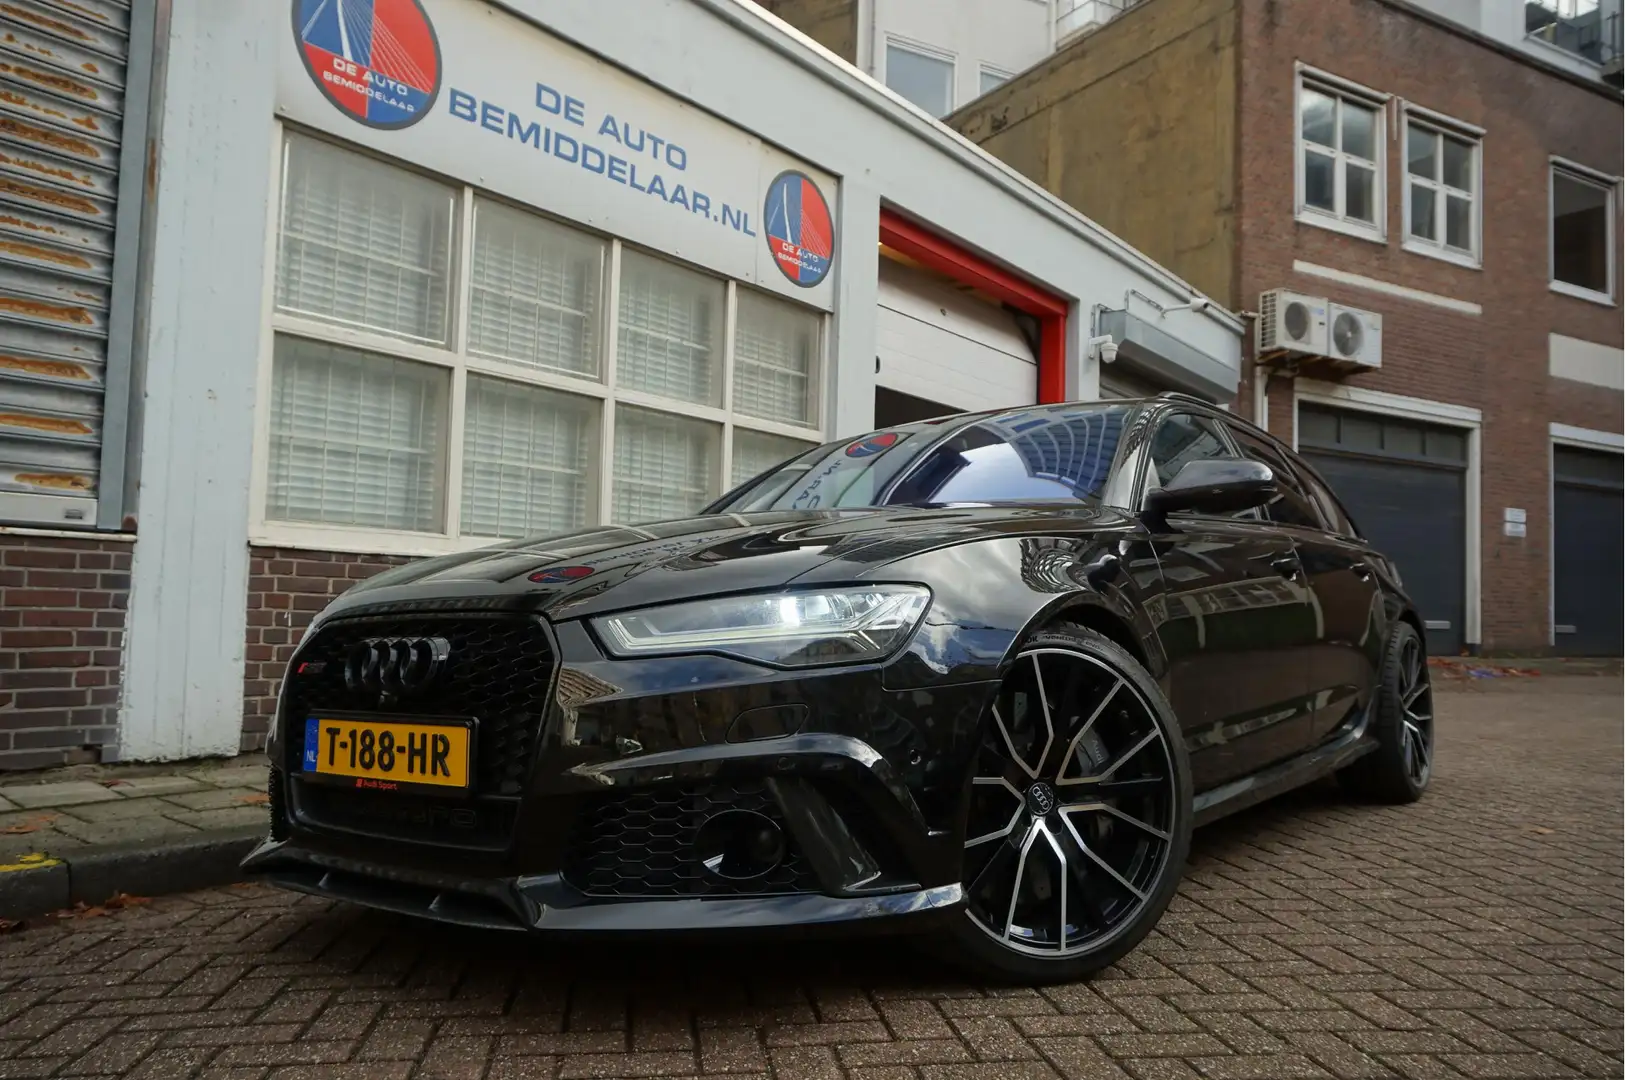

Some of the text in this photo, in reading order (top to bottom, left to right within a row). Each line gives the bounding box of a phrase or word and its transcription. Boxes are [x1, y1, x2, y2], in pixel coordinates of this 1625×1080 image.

[322, 70, 415, 113] BEMIDDELAAR
[333, 57, 408, 96] DE AUTO
[535, 82, 687, 171] DE AUTO
[449, 87, 757, 238] BEMIDDELAAR.NL
[782, 242, 819, 263] DE AUTO
[306, 749, 316, 762] NL
[325, 727, 451, 778] T-188-HR
[363, 780, 398, 791] Audi Sport
